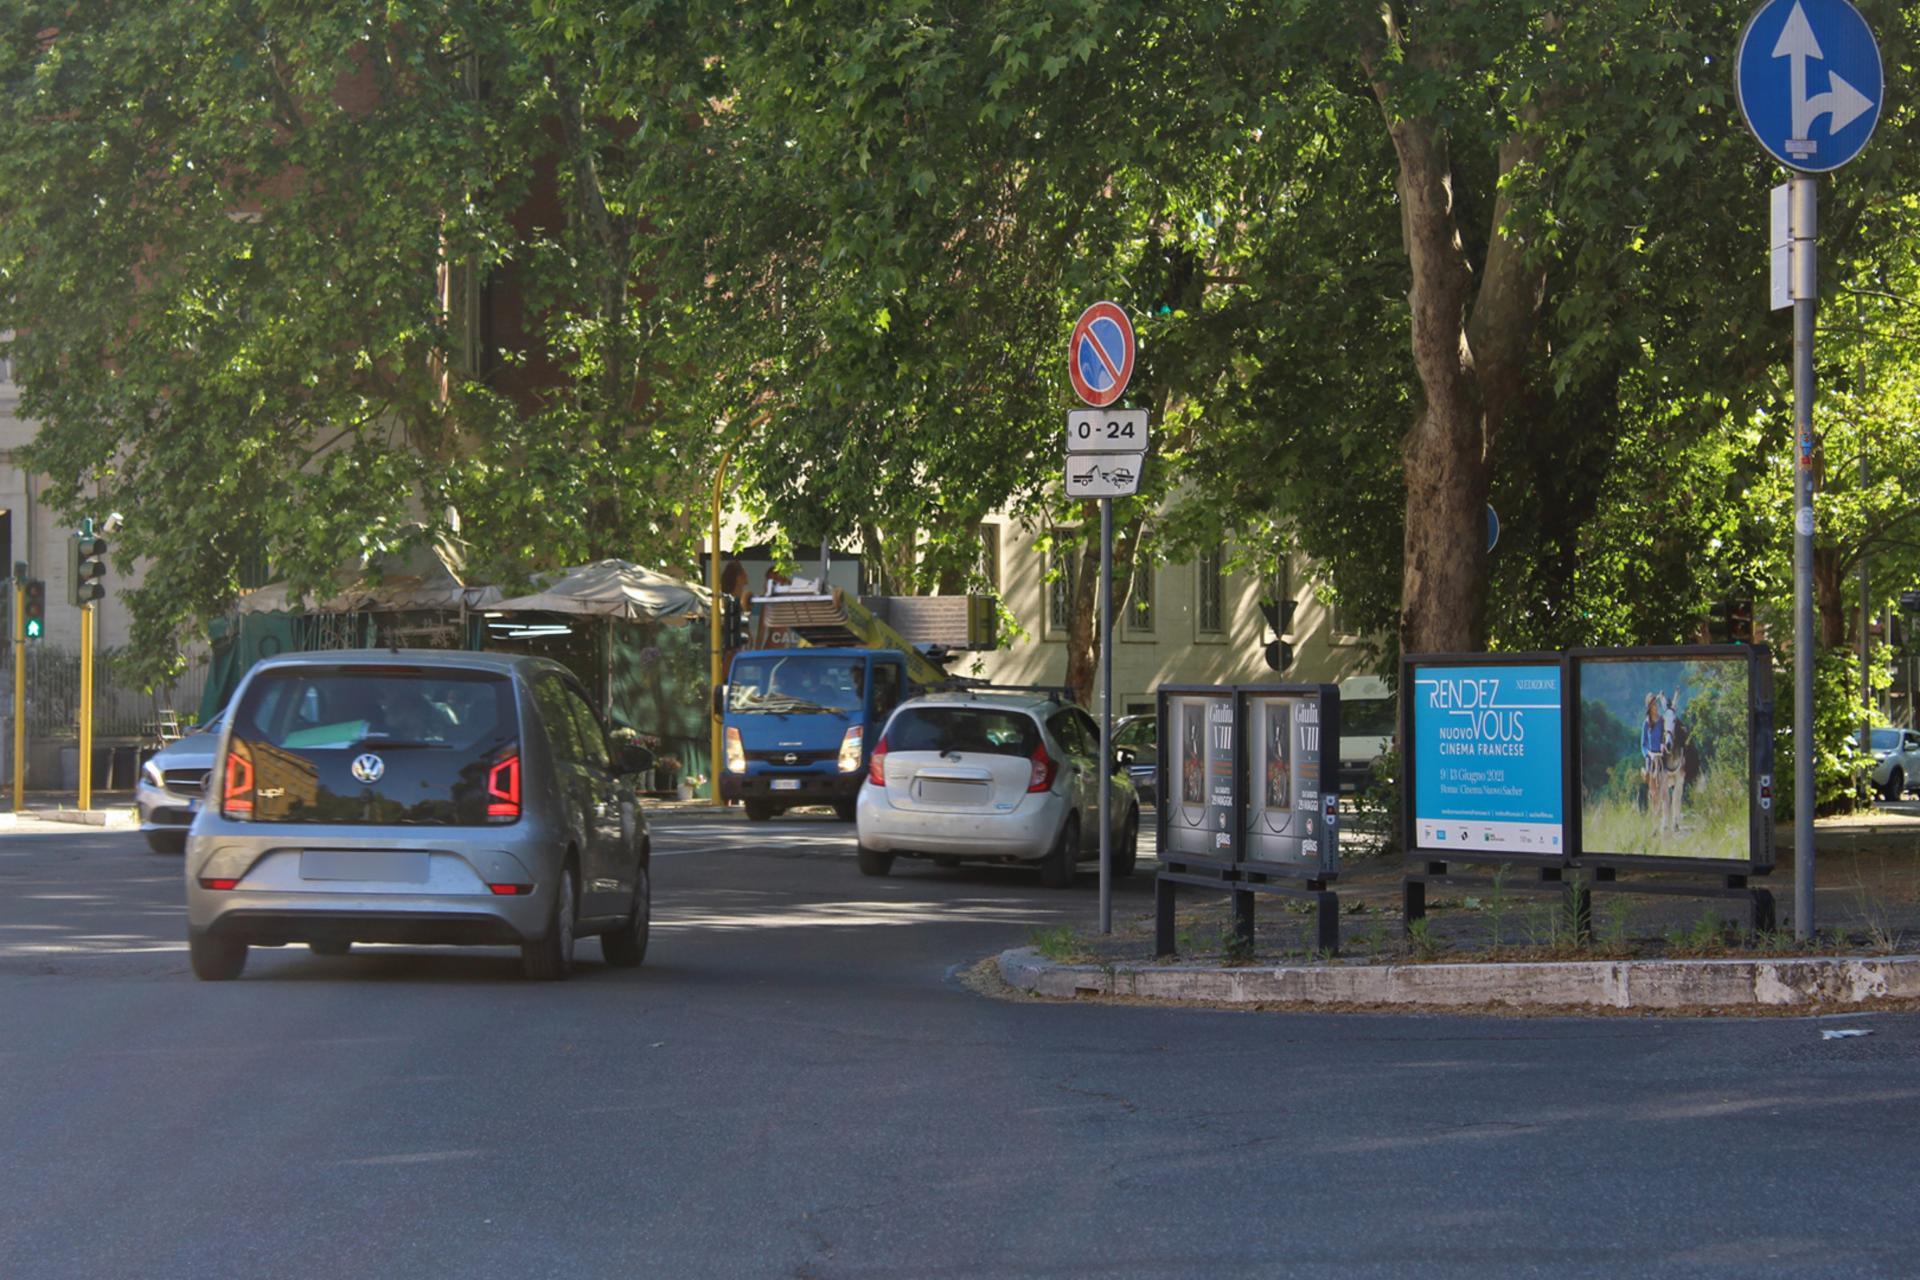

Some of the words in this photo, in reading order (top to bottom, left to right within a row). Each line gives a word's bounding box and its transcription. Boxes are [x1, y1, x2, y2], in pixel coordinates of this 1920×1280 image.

[1427, 679, 1500, 709] RENDEZ
[1439, 726, 1473, 740] NUOVO
[1466, 709, 1525, 742] VOUS
[1439, 742, 1475, 756] CINEMA
[1478, 743, 1525, 757] FRANCESE
